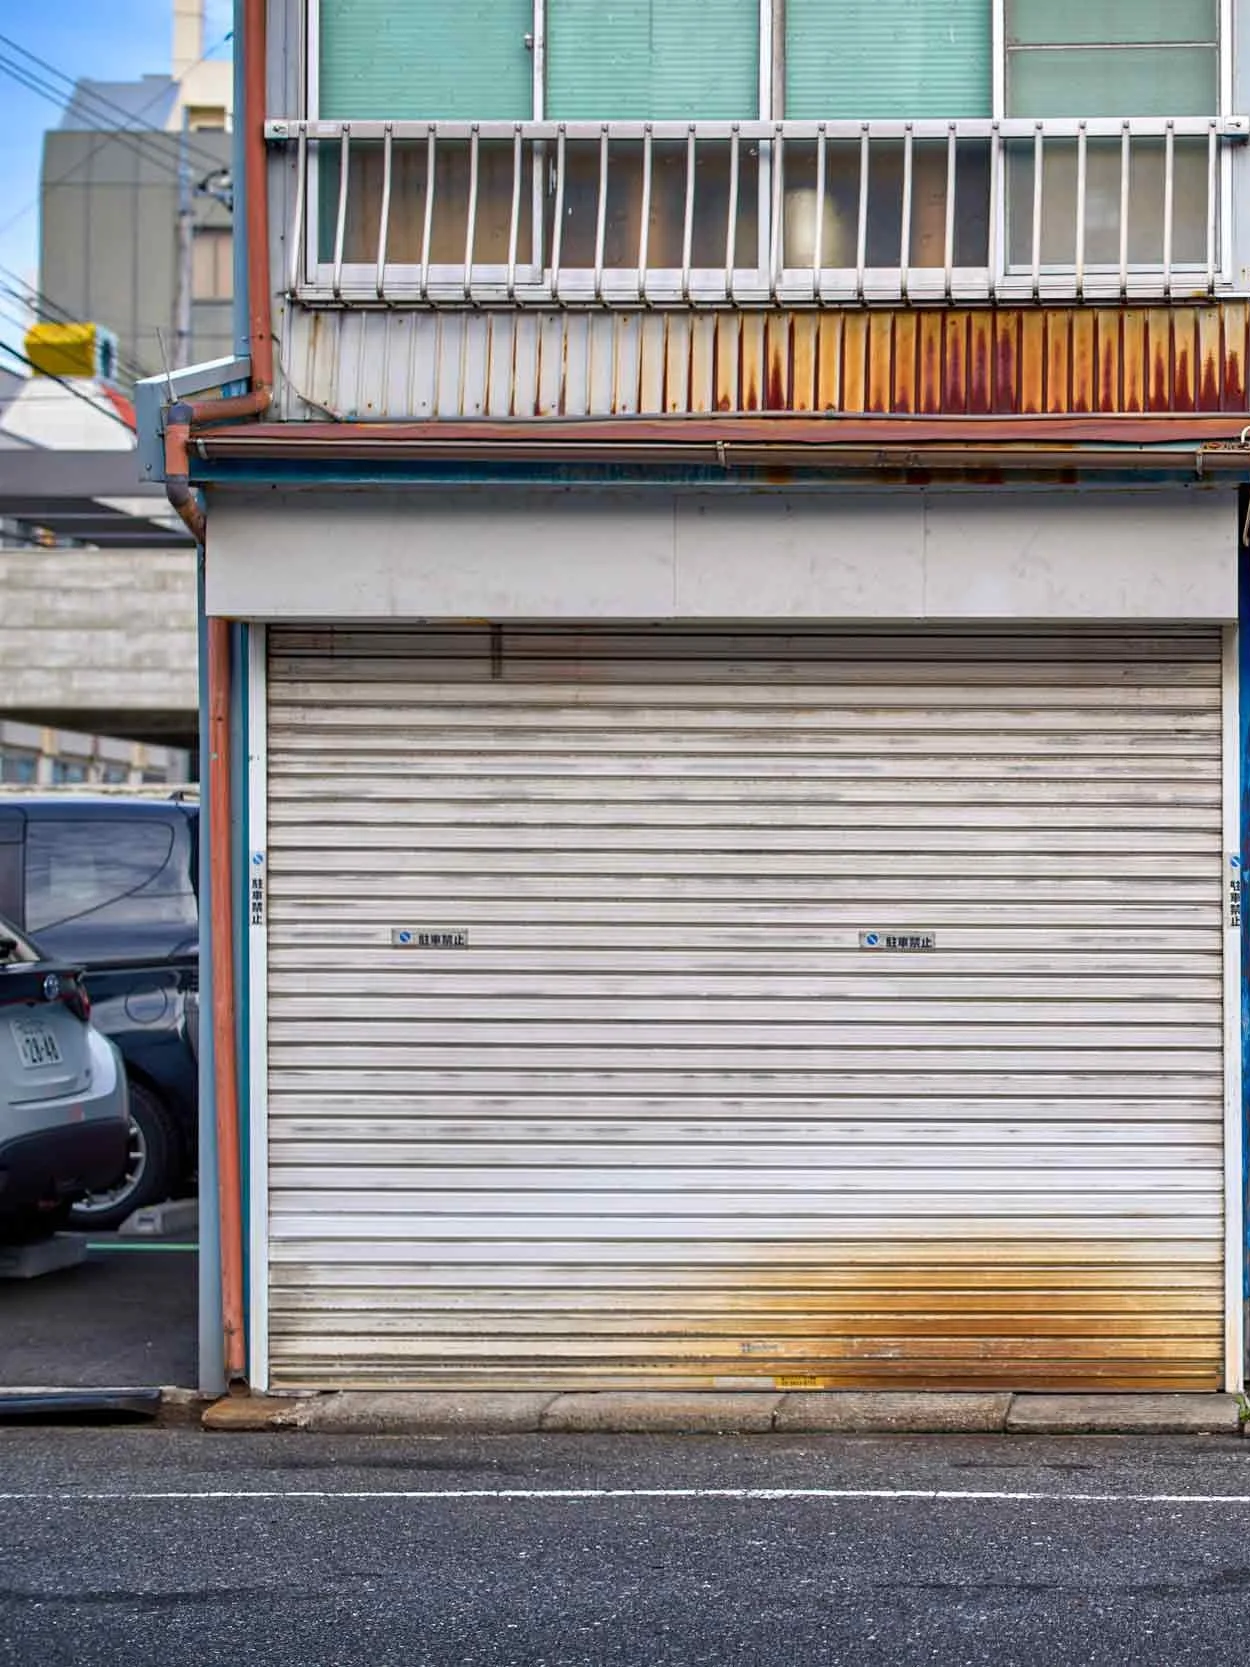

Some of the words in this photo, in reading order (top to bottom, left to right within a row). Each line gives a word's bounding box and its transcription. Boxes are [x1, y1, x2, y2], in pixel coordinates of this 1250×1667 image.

[419, 933, 465, 945] 駐車禁止
[886, 936, 932, 948] 駐車禁止
